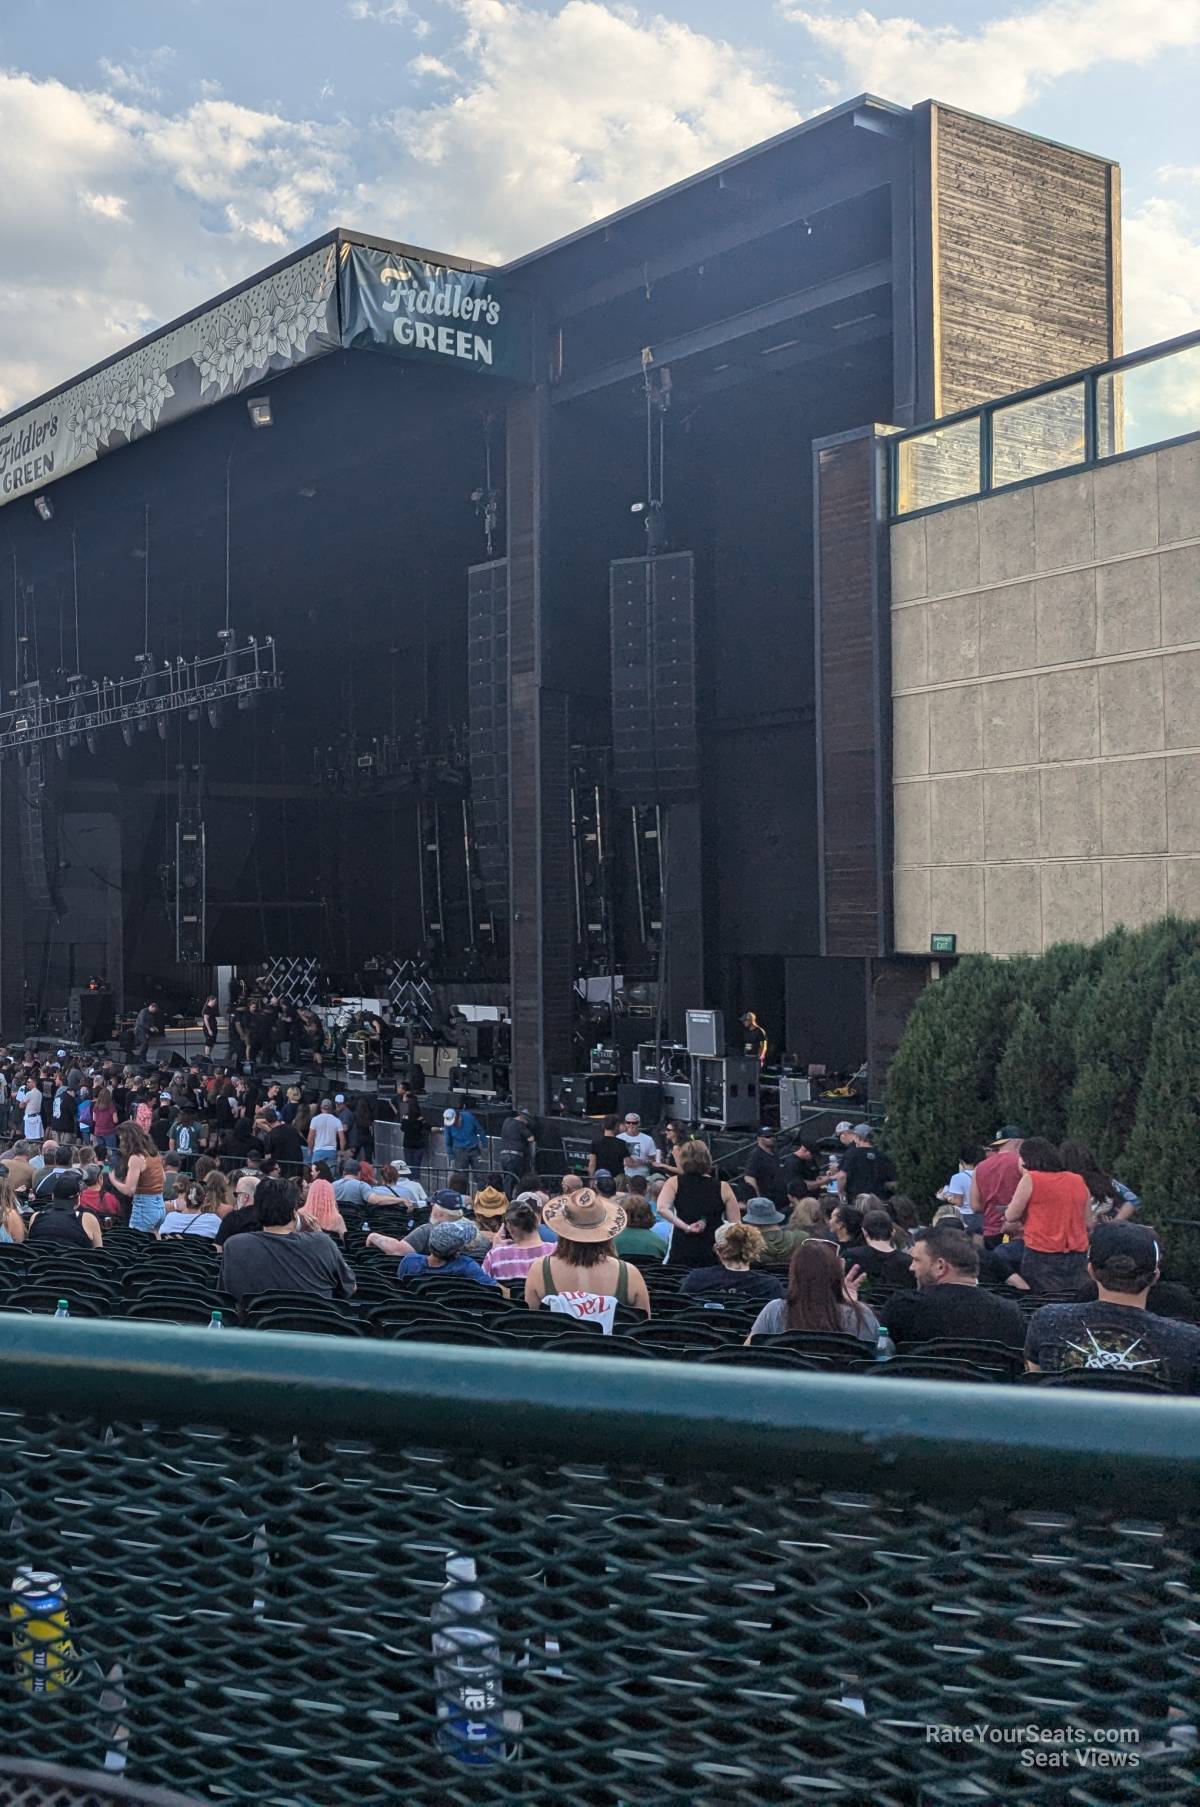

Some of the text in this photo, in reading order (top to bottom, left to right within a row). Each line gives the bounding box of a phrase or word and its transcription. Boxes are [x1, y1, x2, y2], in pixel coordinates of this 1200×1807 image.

[380, 267, 500, 325] Fiddler's
[393, 316, 493, 365] GREEN
[3, 450, 54, 494] GREEN
